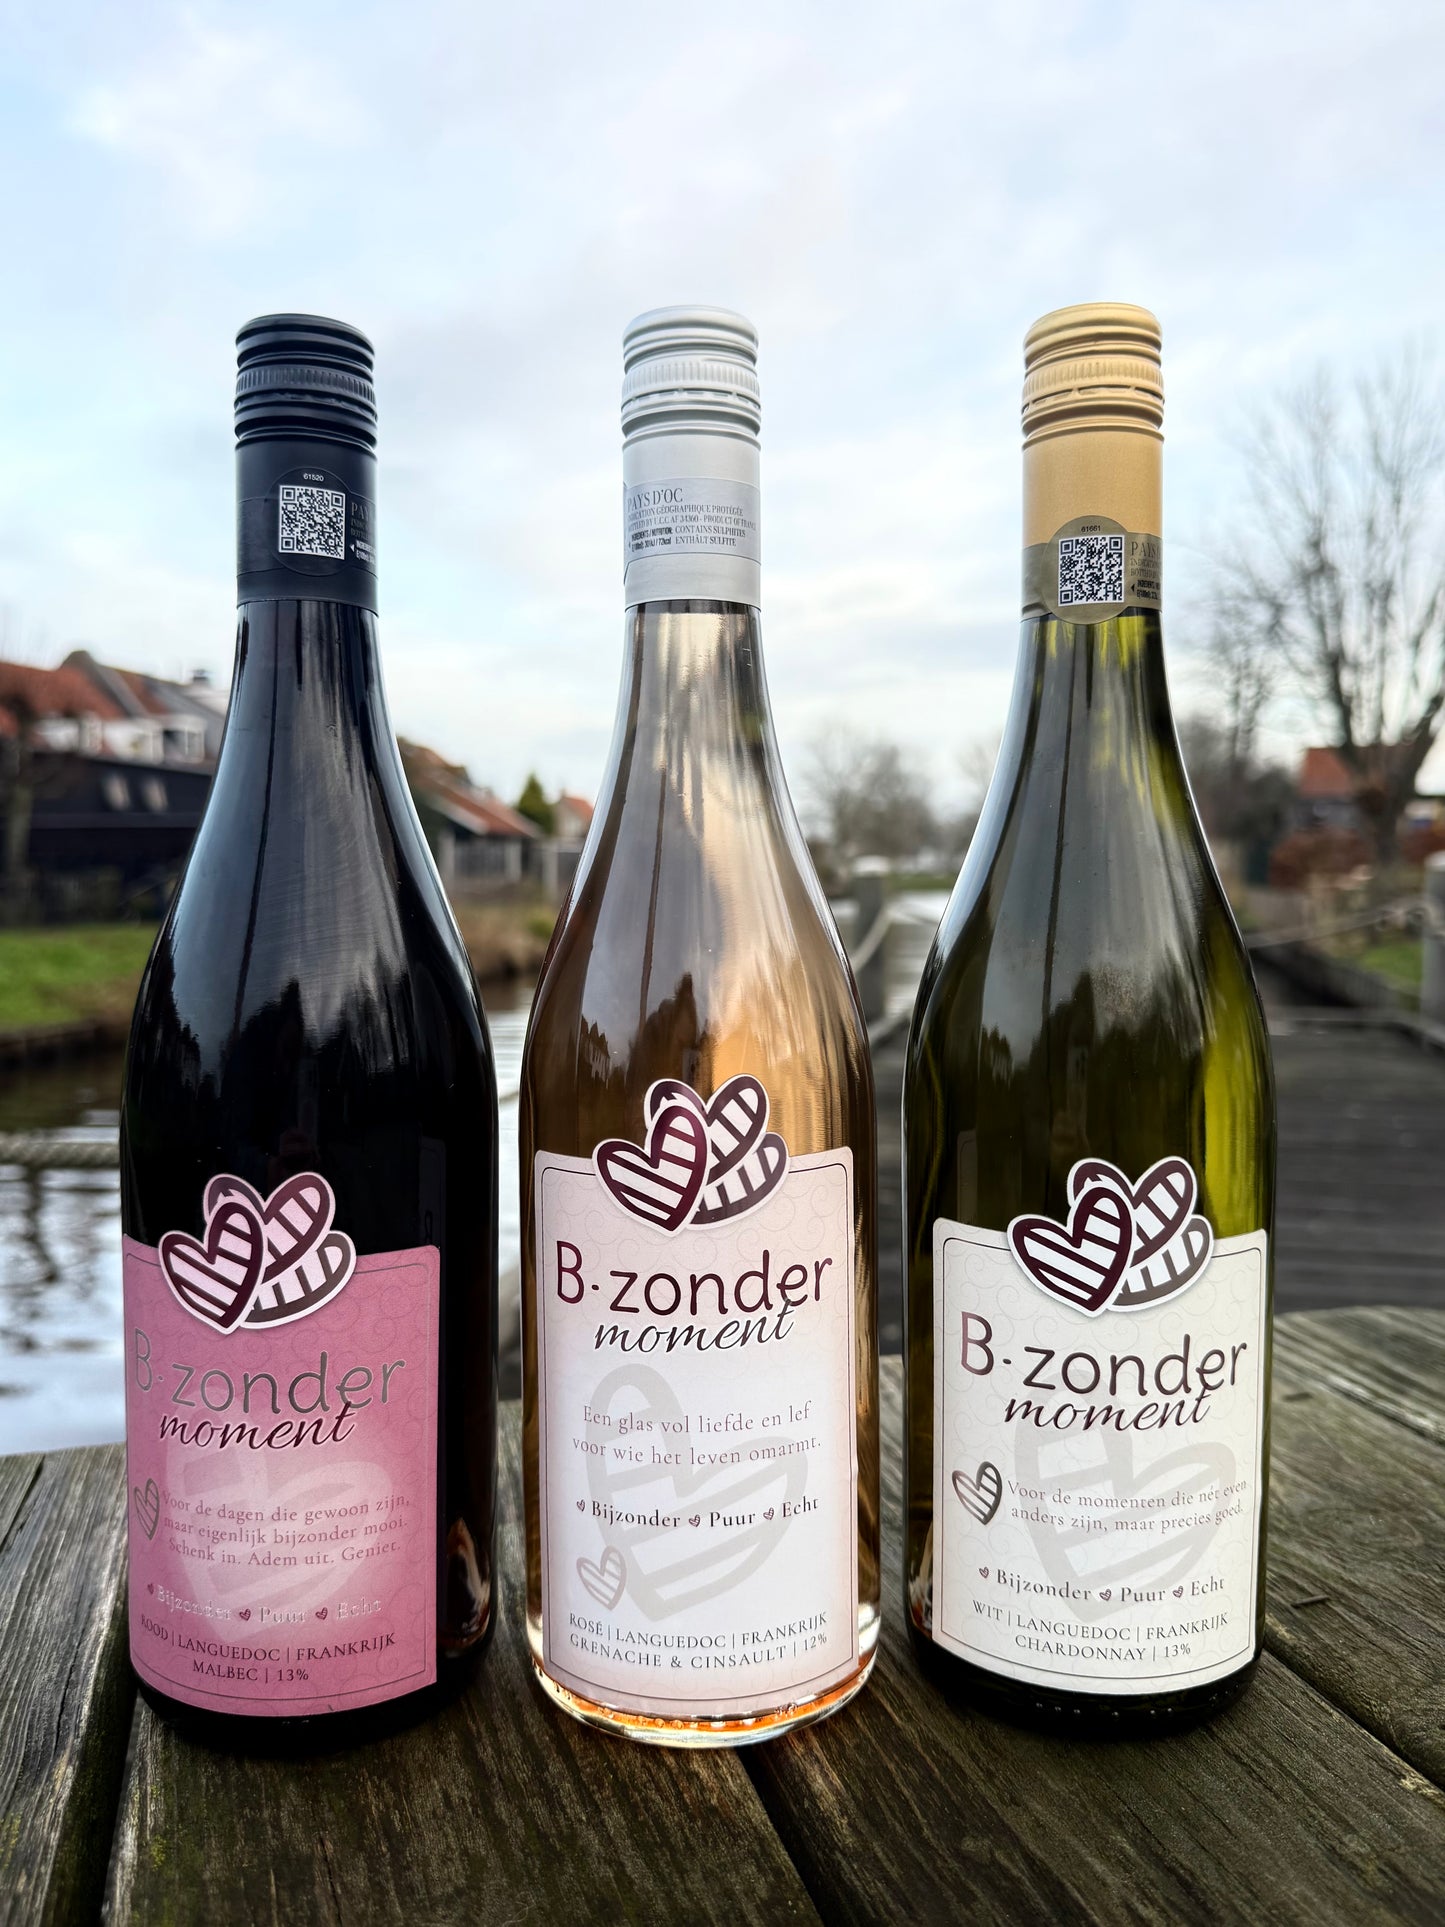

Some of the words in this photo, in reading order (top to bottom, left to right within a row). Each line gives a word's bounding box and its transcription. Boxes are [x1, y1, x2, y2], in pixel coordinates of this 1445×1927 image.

[653, 488, 684, 505] D'OC
[674, 525, 713, 534] CONTAINS
[594, 1297, 795, 1353] moment
[159, 1400, 356, 1450] moment
[583, 1405, 612, 1427] Een
[618, 1412, 654, 1435] glas
[661, 1415, 690, 1433] vol
[698, 1414, 754, 1433] liefde
[761, 1415, 782, 1429] en
[789, 1400, 812, 1422] lef
[1003, 1386, 1212, 1432] moment
[572, 1437, 607, 1457] voor
[613, 1445, 644, 1463] wie
[651, 1446, 682, 1465] het
[690, 1447, 741, 1465] leven
[748, 1436, 822, 1462] omarmt.
[162, 1490, 191, 1512] Voor
[195, 1499, 212, 1516] de
[217, 1503, 265, 1525] dagen
[270, 1506, 298, 1522] die
[304, 1498, 369, 1526] gewoon
[376, 1494, 411, 1515] zijn,
[1007, 1479, 1046, 1501] Voor
[1051, 1488, 1072, 1505] de
[1077, 1494, 1166, 1509] momenten
[1170, 1491, 1194, 1506] die
[1223, 1479, 1248, 1497] even
[591, 1499, 681, 1528] Bijzonder
[709, 1511, 757, 1528] Puur
[782, 1496, 820, 1519] Echt
[1011, 1505, 1064, 1527] anders
[1070, 1514, 1108, 1534] zijn,
[1114, 1518, 1156, 1531] maar
[1161, 1512, 1212, 1534] precies
[164, 1516, 195, 1535] maar
[198, 1525, 267, 1548] eigenlijk
[273, 1526, 357, 1546] bijzonder
[169, 1536, 216, 1562] Schenk
[247, 1551, 299, 1567] Adem
[996, 1567, 1093, 1601] Bijzonder
[1120, 1586, 1167, 1603] Puur
[1190, 1575, 1226, 1598] Echt
[258, 1606, 307, 1624] Puur
[336, 1596, 383, 1620] Echt
[972, 1599, 1004, 1622] WIT
[1016, 1613, 1131, 1641] LANGUEDOC
[1146, 1611, 1229, 1641] FRANKRIJK
[568, 1612, 604, 1636] ROSÉ
[615, 1628, 727, 1649] LANGUEDOC
[741, 1611, 828, 1647] FRANKRIJK
[177, 1634, 281, 1662] LANGUEDOC
[296, 1632, 397, 1662] FRANKRIJK
[569, 1633, 663, 1667] GRENACHE
[670, 1655, 683, 1668] &
[690, 1644, 788, 1669] CINSAULT
[803, 1632, 828, 1652] 12%
[1014, 1634, 1147, 1661] CHARDONNAY
[1163, 1643, 1192, 1659] 13%
[192, 1660, 259, 1682] MALBEC
[276, 1668, 310, 1683] 13%
